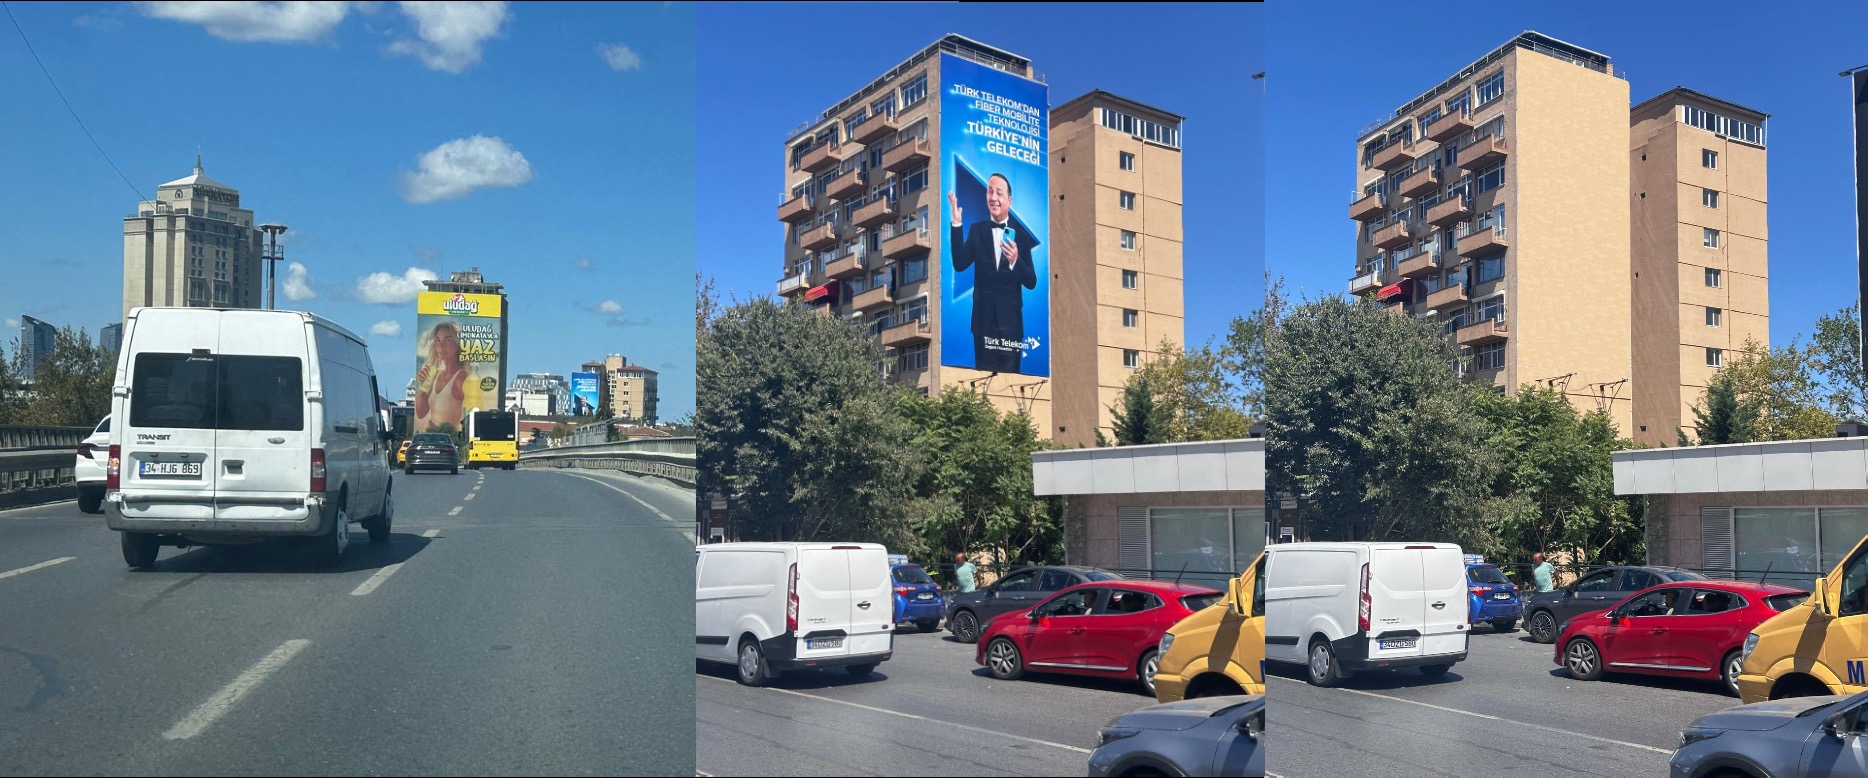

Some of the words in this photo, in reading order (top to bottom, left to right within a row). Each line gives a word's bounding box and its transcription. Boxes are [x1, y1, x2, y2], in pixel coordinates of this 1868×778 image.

[954, 84, 979, 98] TÜRK
[981, 91, 1040, 117] TELEKOM'DAN
[966, 120, 1040, 151] TÜRKİYE'NİN
[986, 140, 1040, 166] GELECEĞİ
[460, 339, 495, 355] YAZ
[984, 336, 1000, 346] Türk
[1001, 338, 1029, 350] Telekom
[137, 433, 171, 441] TRANSIT
[146, 463, 156, 473] 34
[160, 464, 177, 474] HJG
[182, 464, 199, 474] 869
